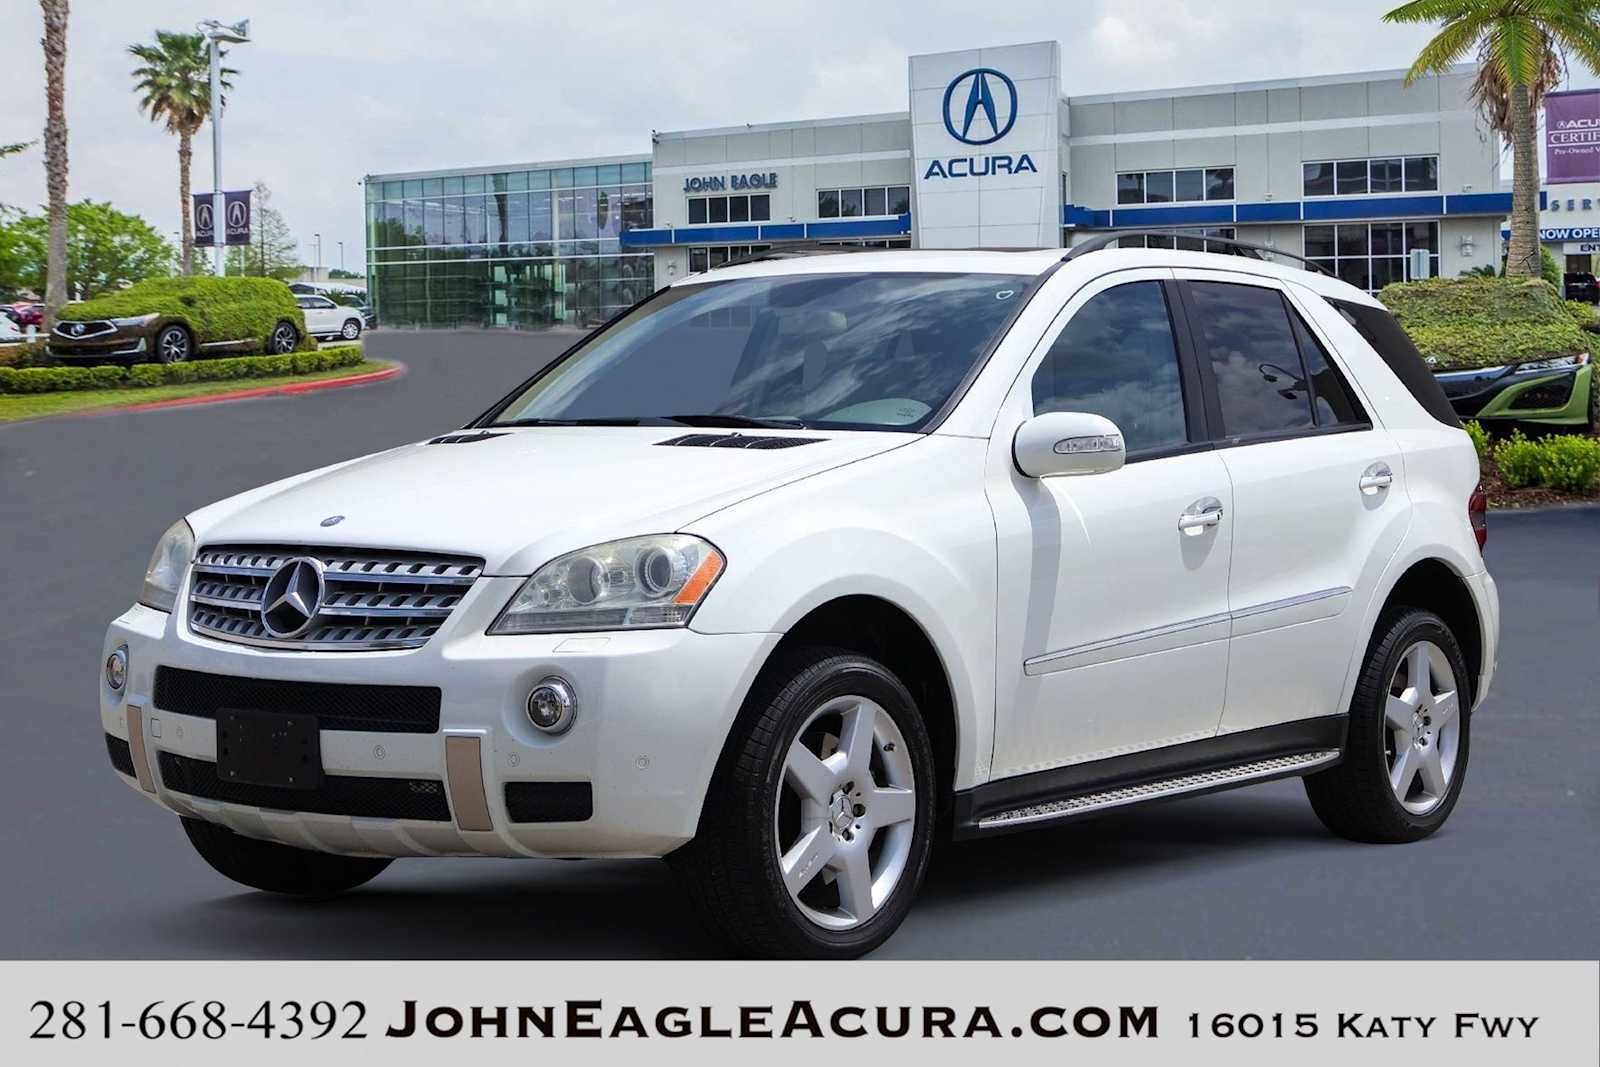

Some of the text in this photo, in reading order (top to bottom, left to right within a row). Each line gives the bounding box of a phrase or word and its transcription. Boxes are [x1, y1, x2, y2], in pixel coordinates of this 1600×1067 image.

[1566, 119, 1600, 129] ACU
[923, 153, 1038, 180] ACURA
[683, 172, 778, 192] JOHN EAGLE
[1572, 228, 1600, 239] OPE
